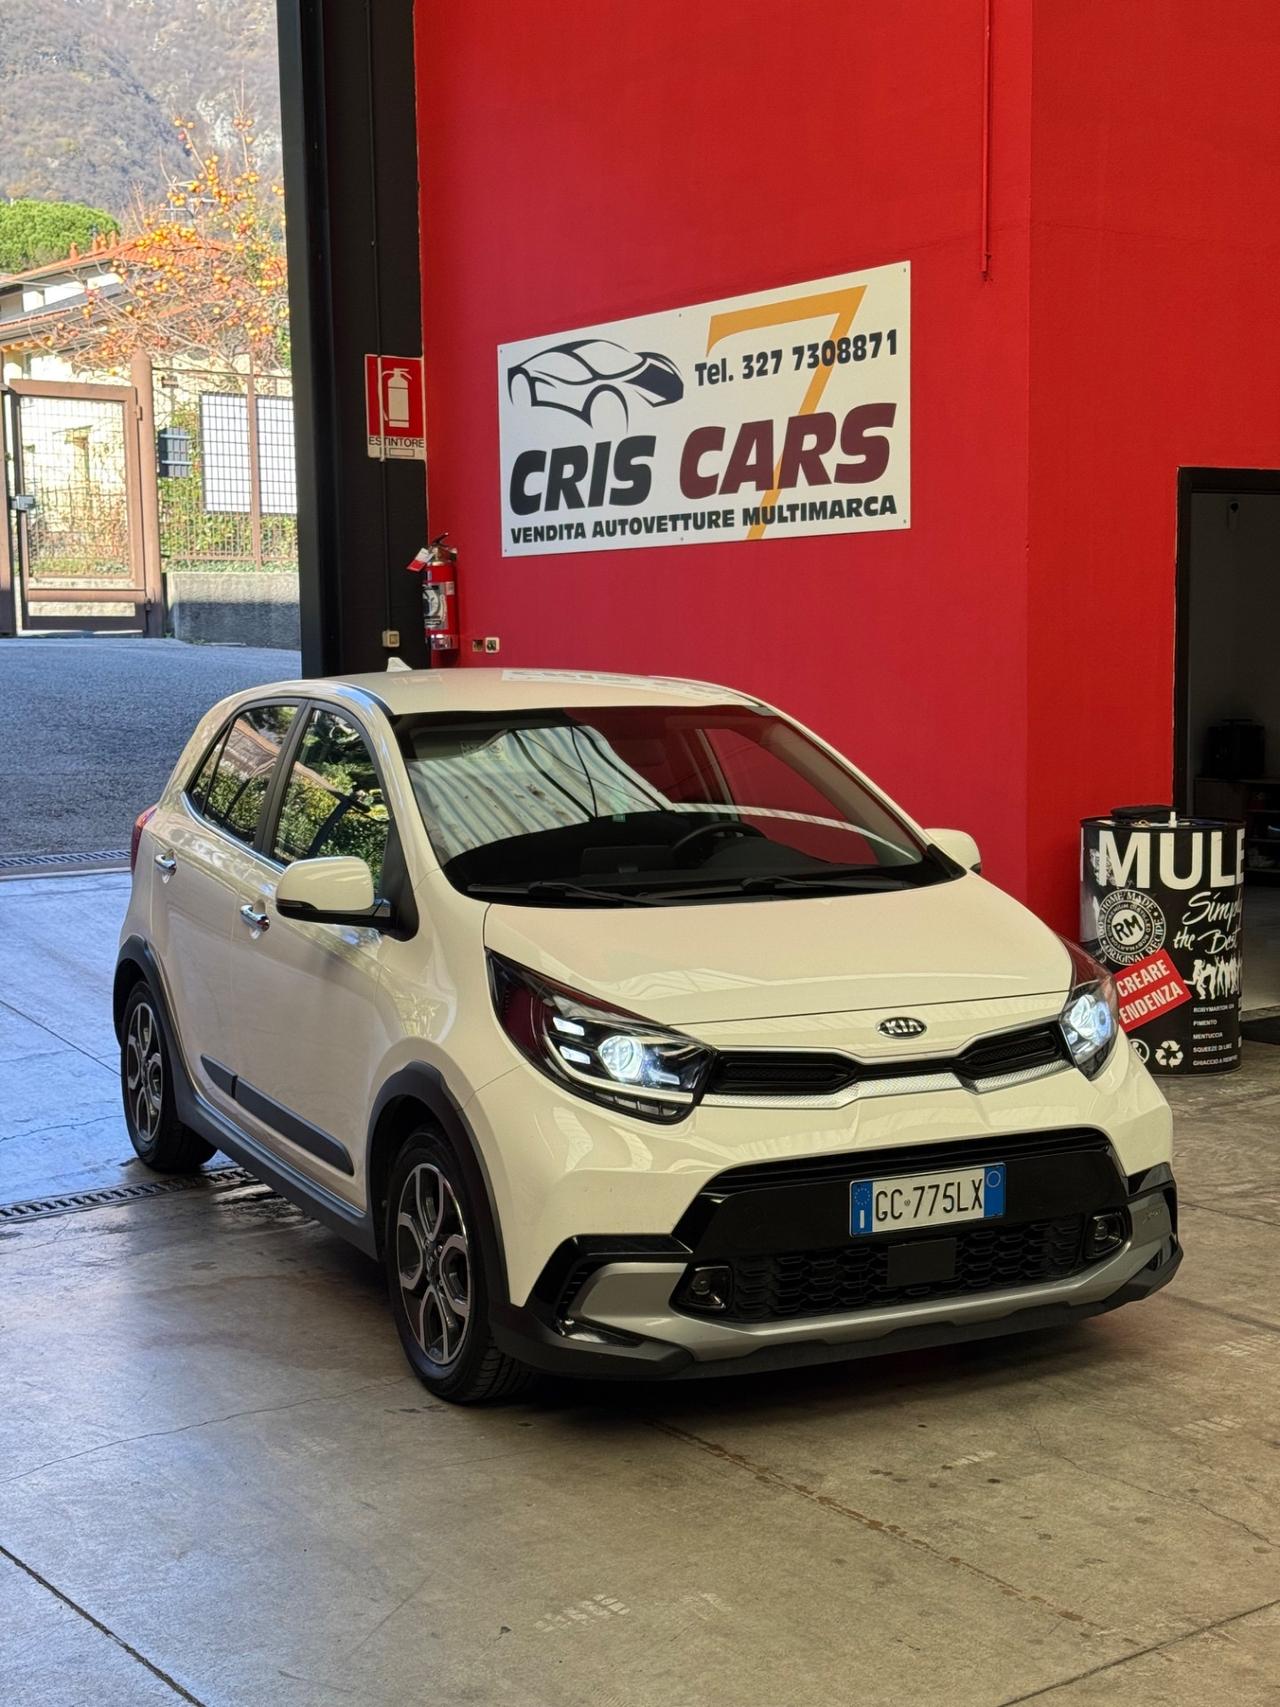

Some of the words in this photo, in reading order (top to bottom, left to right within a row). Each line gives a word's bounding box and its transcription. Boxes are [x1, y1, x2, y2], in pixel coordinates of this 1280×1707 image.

[694, 357, 734, 387] Tel.
[742, 348, 783, 380] 327
[792, 328, 897, 372] 7308871
[368, 436, 425, 448] ESTINTORE
[509, 435, 656, 516] CRIS
[679, 403, 897, 500] CARS
[511, 522, 586, 544] VENDITA
[592, 509, 734, 538] AUTOVETTURE
[742, 494, 898, 527] MULTIMARCA
[1127, 891, 1154, 912] MADE
[1113, 914, 1143, 941] RM
[1173, 926, 1196, 951] the
[1197, 924, 1241, 954] Best
[1116, 959, 1170, 997] CREARE
[1118, 981, 1184, 1024] ENDENZA
[885, 1019, 922, 1034] KIA
